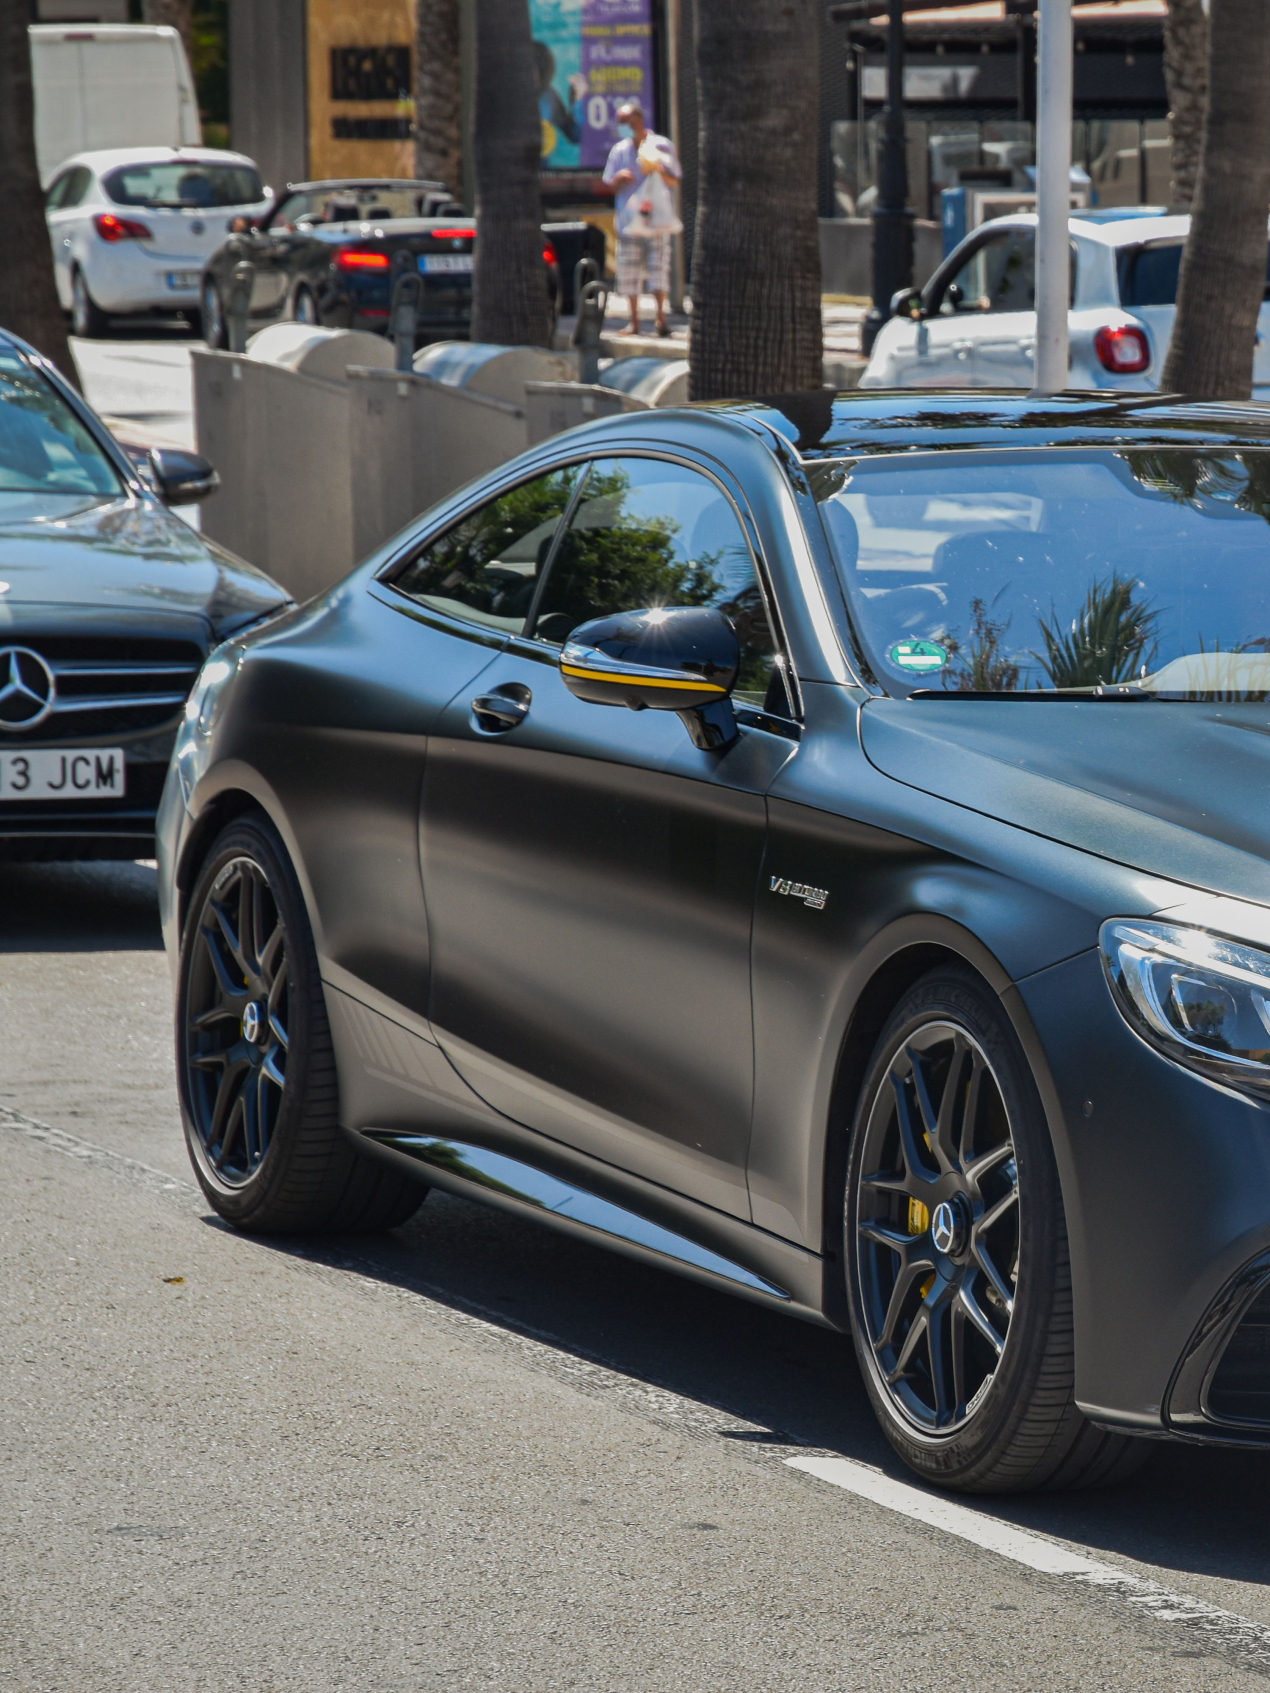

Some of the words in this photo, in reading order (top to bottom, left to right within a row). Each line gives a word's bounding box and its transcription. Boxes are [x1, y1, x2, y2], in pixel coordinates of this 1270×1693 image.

[911, 642, 926, 656] 4
[0, 756, 31, 791] 3
[47, 754, 115, 791] JCM
[769, 876, 792, 896] V8
